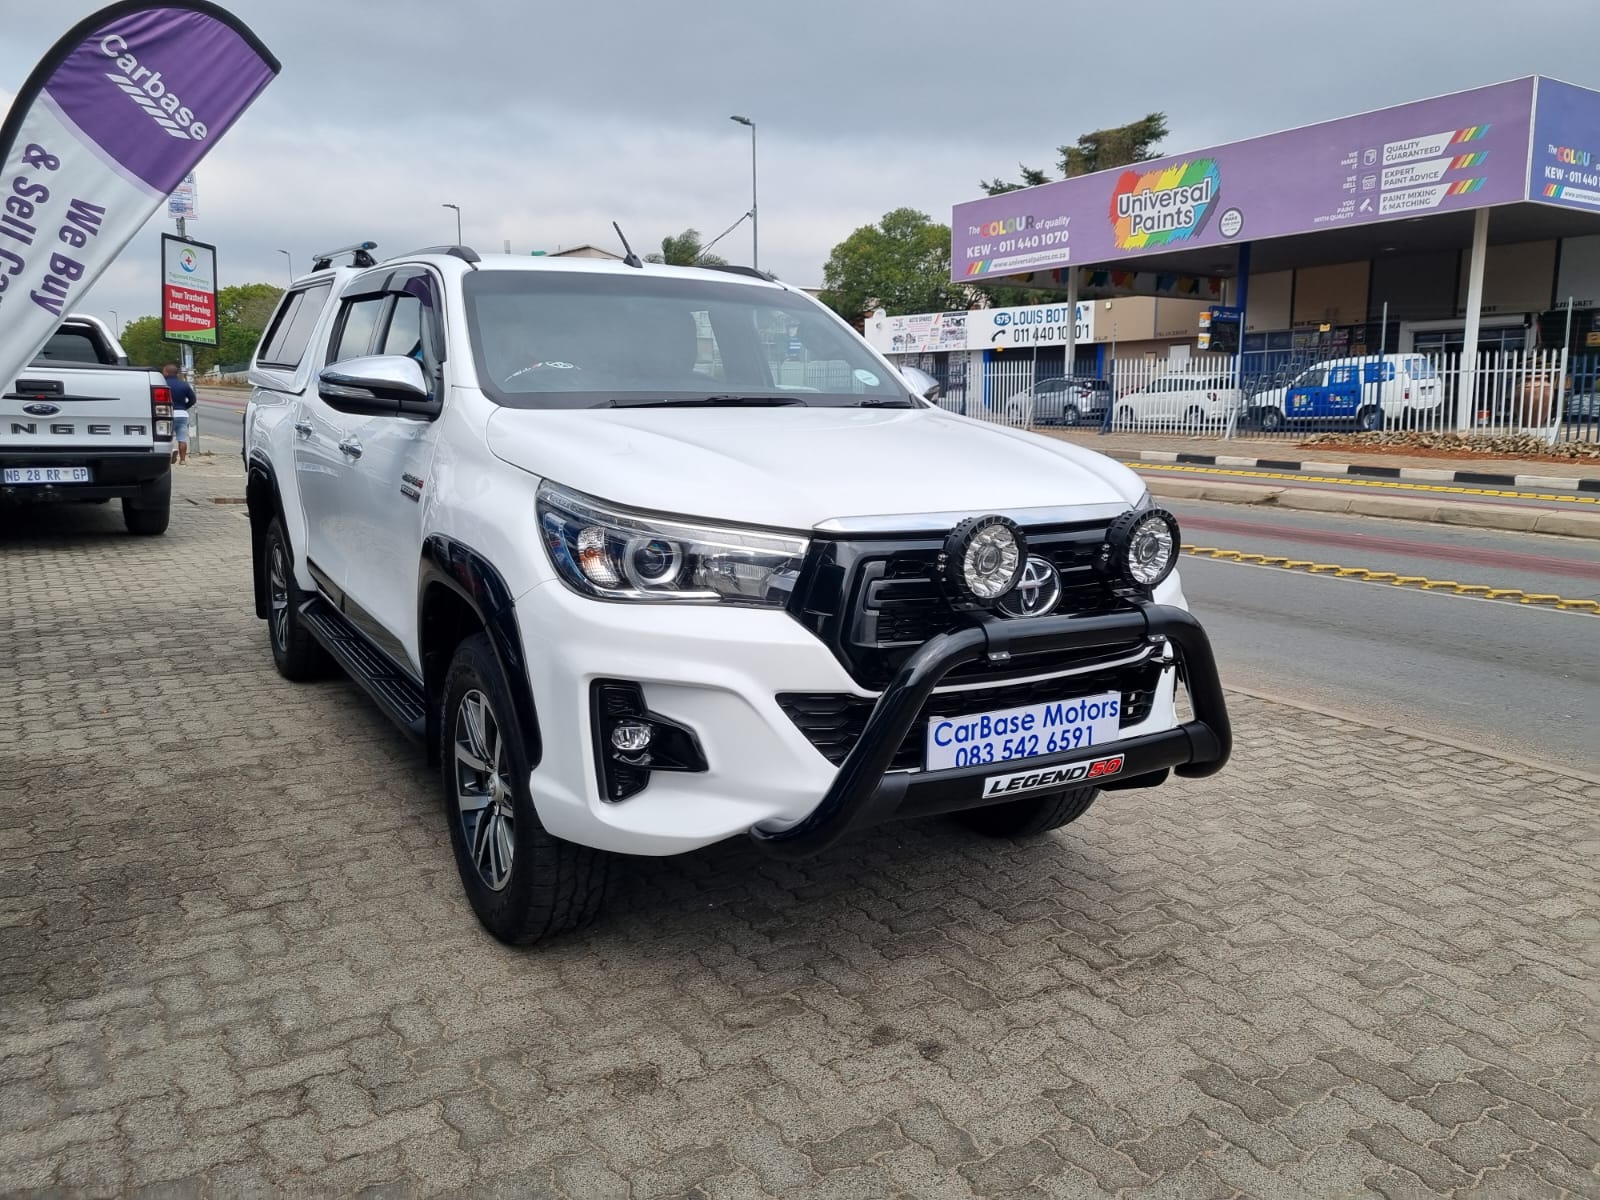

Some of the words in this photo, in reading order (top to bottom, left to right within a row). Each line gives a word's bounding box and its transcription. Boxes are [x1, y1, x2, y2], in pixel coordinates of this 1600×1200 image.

[100, 34, 208, 141] Carbase
[22, 143, 61, 171] &
[1386, 141, 1421, 155] QUALITY
[1386, 145, 1441, 162] GUARANTEED
[1384, 176, 1408, 187] PAINT
[1409, 171, 1440, 182] ADVICE
[1385, 167, 1416, 179] EXPERT
[1545, 166, 1565, 181] KEW
[1569, 171, 1582, 184] 011
[1582, 173, 1598, 187] 440
[1118, 179, 1210, 216] Universal
[1383, 193, 1406, 204] PAINT
[1408, 188, 1437, 200] MIXING
[1389, 198, 1431, 210] MATCHING
[0, 176, 50, 246] Sell
[1132, 206, 1194, 234] Paints
[1330, 211, 1355, 222] QUALITY
[58, 198, 106, 249] We
[968, 226, 981, 237] The
[981, 215, 1034, 238] COLOUR
[1035, 219, 1044, 231] of
[1044, 216, 1071, 230] quality
[966, 243, 991, 259] KEW
[999, 239, 1015, 253] 011
[1017, 235, 1039, 249] 440
[1041, 230, 1069, 246] 1070
[30, 252, 86, 317] Buy
[184, 291, 203, 304] Trusted
[169, 311, 185, 322] Local
[185, 314, 211, 328] Pharmacy
[191, 304, 211, 317] Serving
[1012, 309, 1043, 326] LOUIS
[1046, 306, 1083, 324] BOTA
[1014, 328, 1030, 343] 011
[1033, 326, 1055, 341] 440
[0, 423, 147, 435] NGER
[5, 470, 21, 482] NB
[27, 470, 41, 482] 28
[46, 469, 62, 481] RR
[73, 469, 87, 481] GP
[934, 712, 1036, 747] CarBase
[1042, 698, 1119, 729] Motors
[955, 741, 995, 768] 083
[1001, 733, 1039, 761] 542
[1046, 724, 1093, 754] 6591
